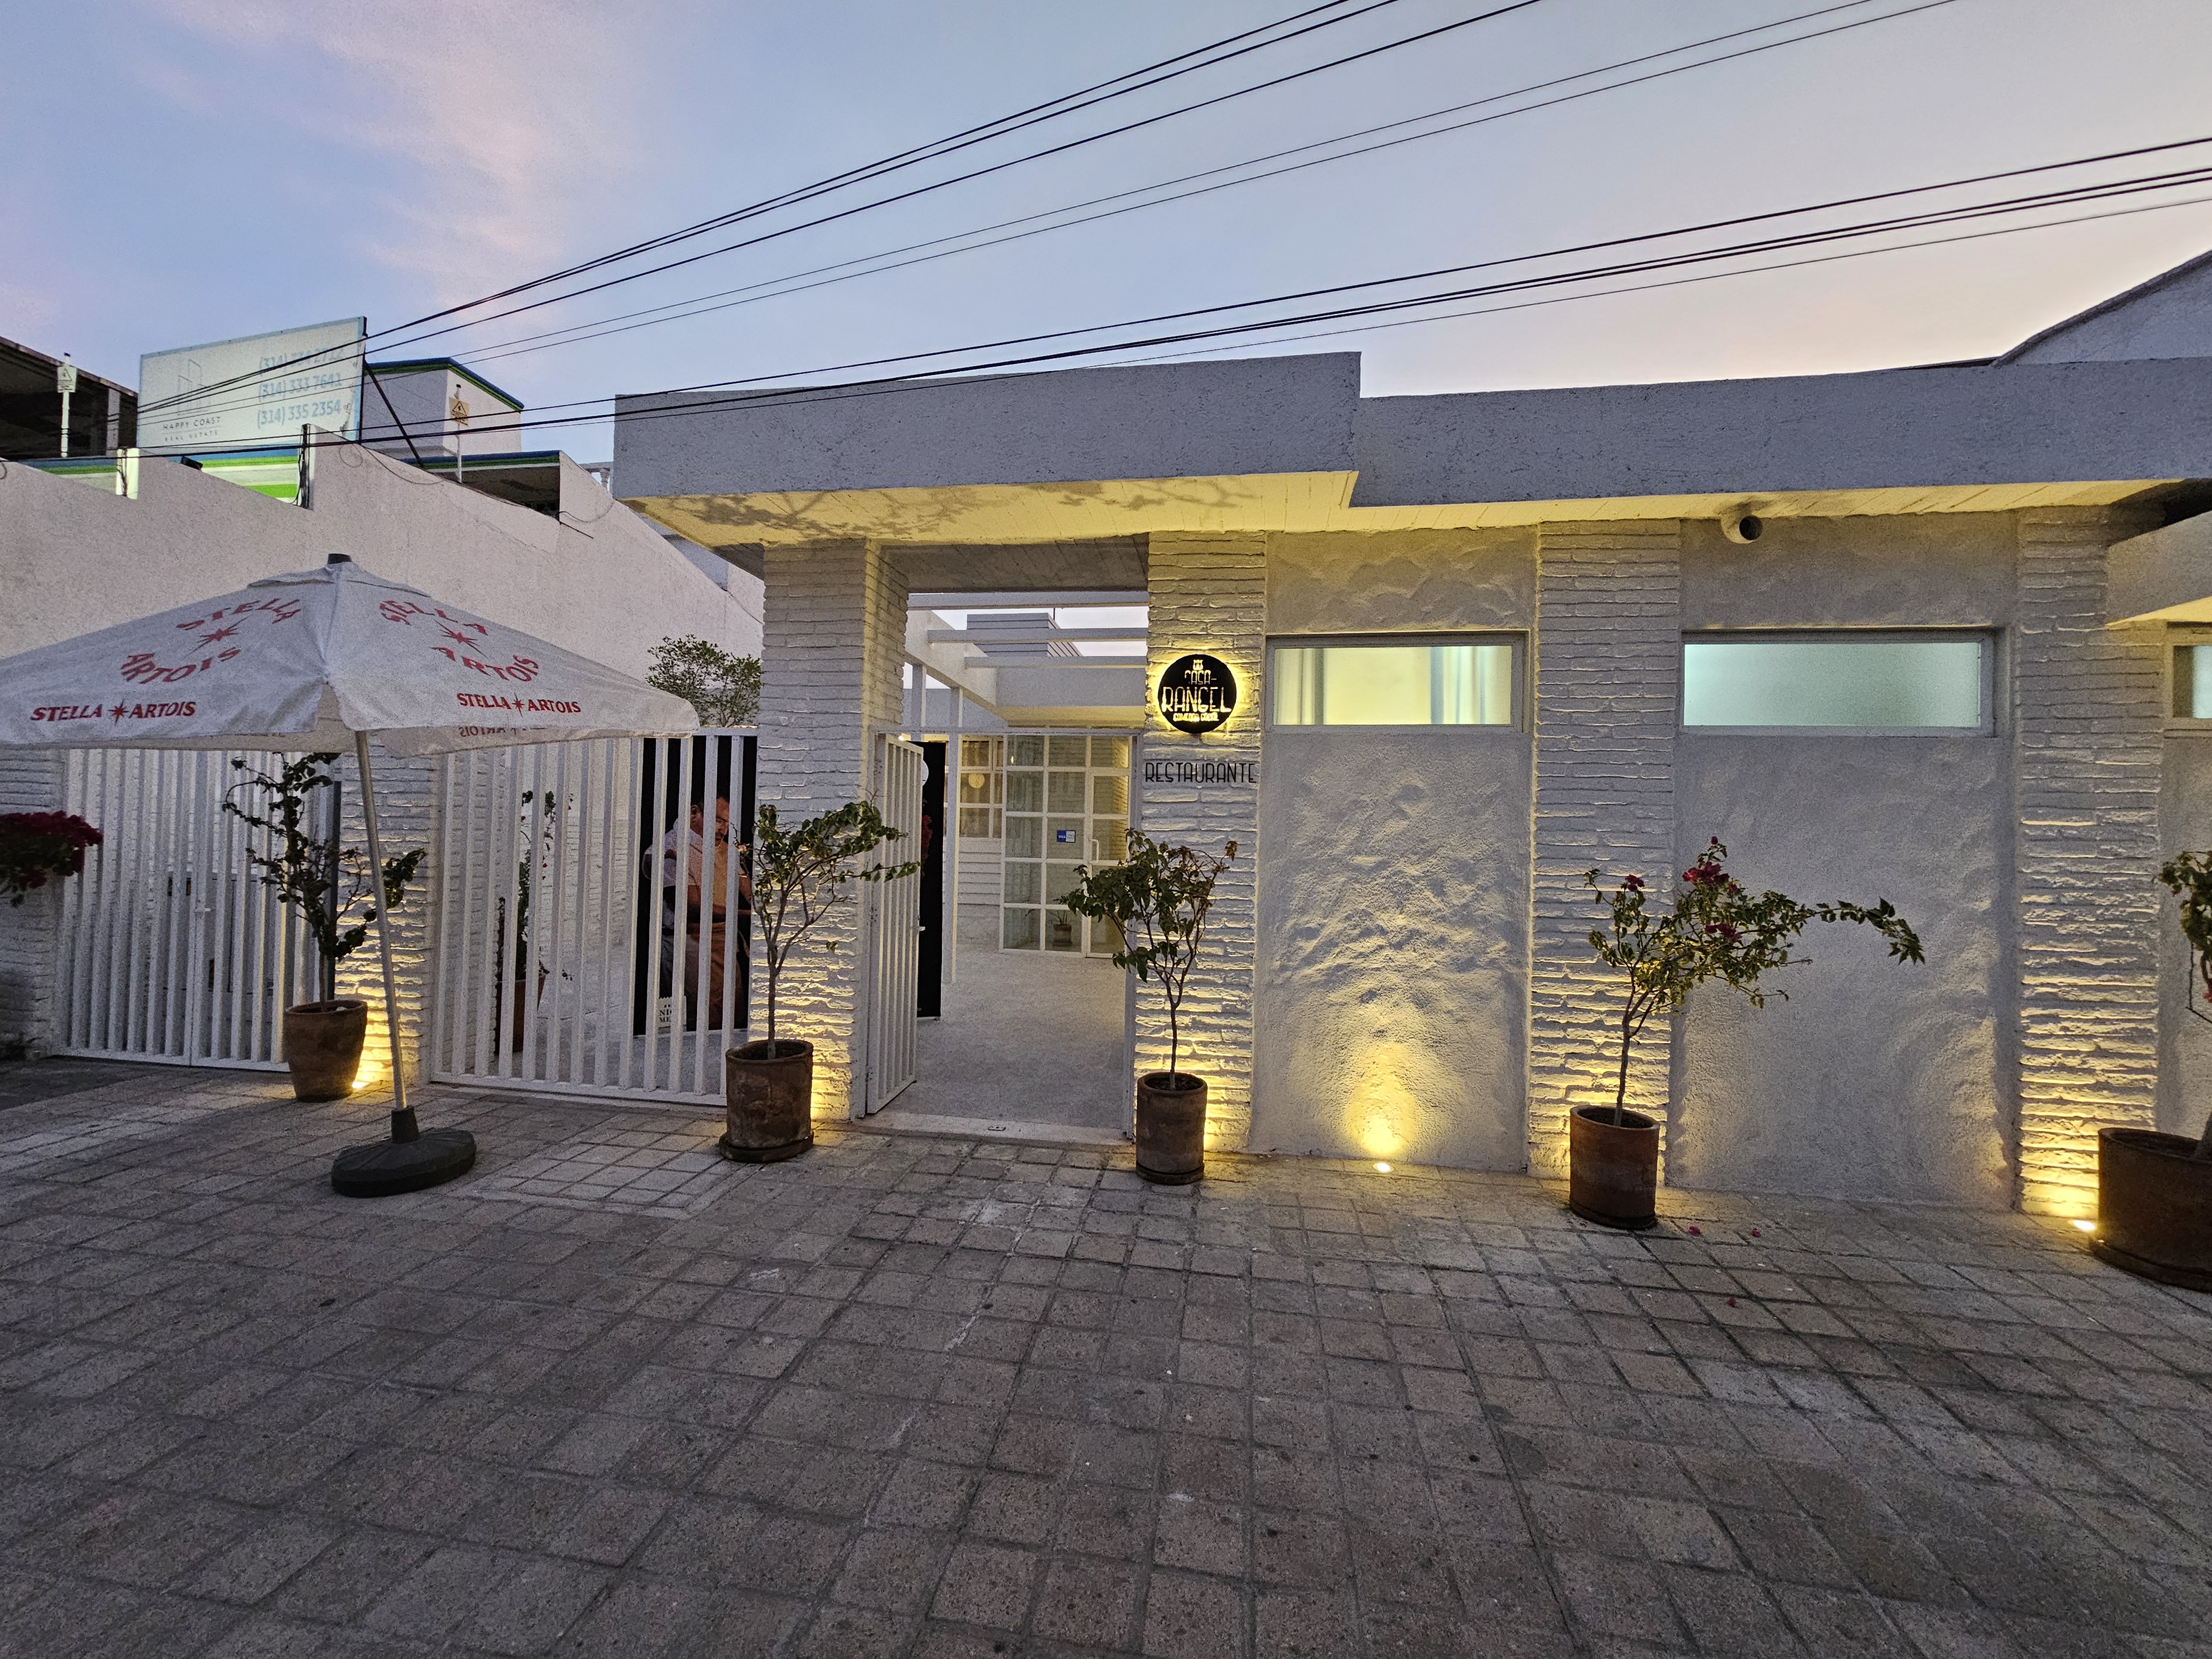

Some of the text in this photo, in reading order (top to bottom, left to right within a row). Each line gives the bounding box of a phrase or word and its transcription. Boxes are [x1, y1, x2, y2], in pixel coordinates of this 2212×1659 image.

[258, 372, 342, 403] (314) 333 7641
[163, 416, 221, 430] HAPPY COAST
[257, 399, 341, 429] (314) 335 2354
[176, 598, 301, 630] STELLA
[379, 599, 488, 636] STELLA
[121, 647, 241, 684] ARTOIS
[429, 645, 539, 682] ARTOIS
[29, 701, 197, 722] STELLA ARTOIS
[457, 692, 581, 713] STELLA ARTOIS
[1161, 686, 1232, 713] RANGEL
[1145, 762, 1257, 784] RESTAURANTE
